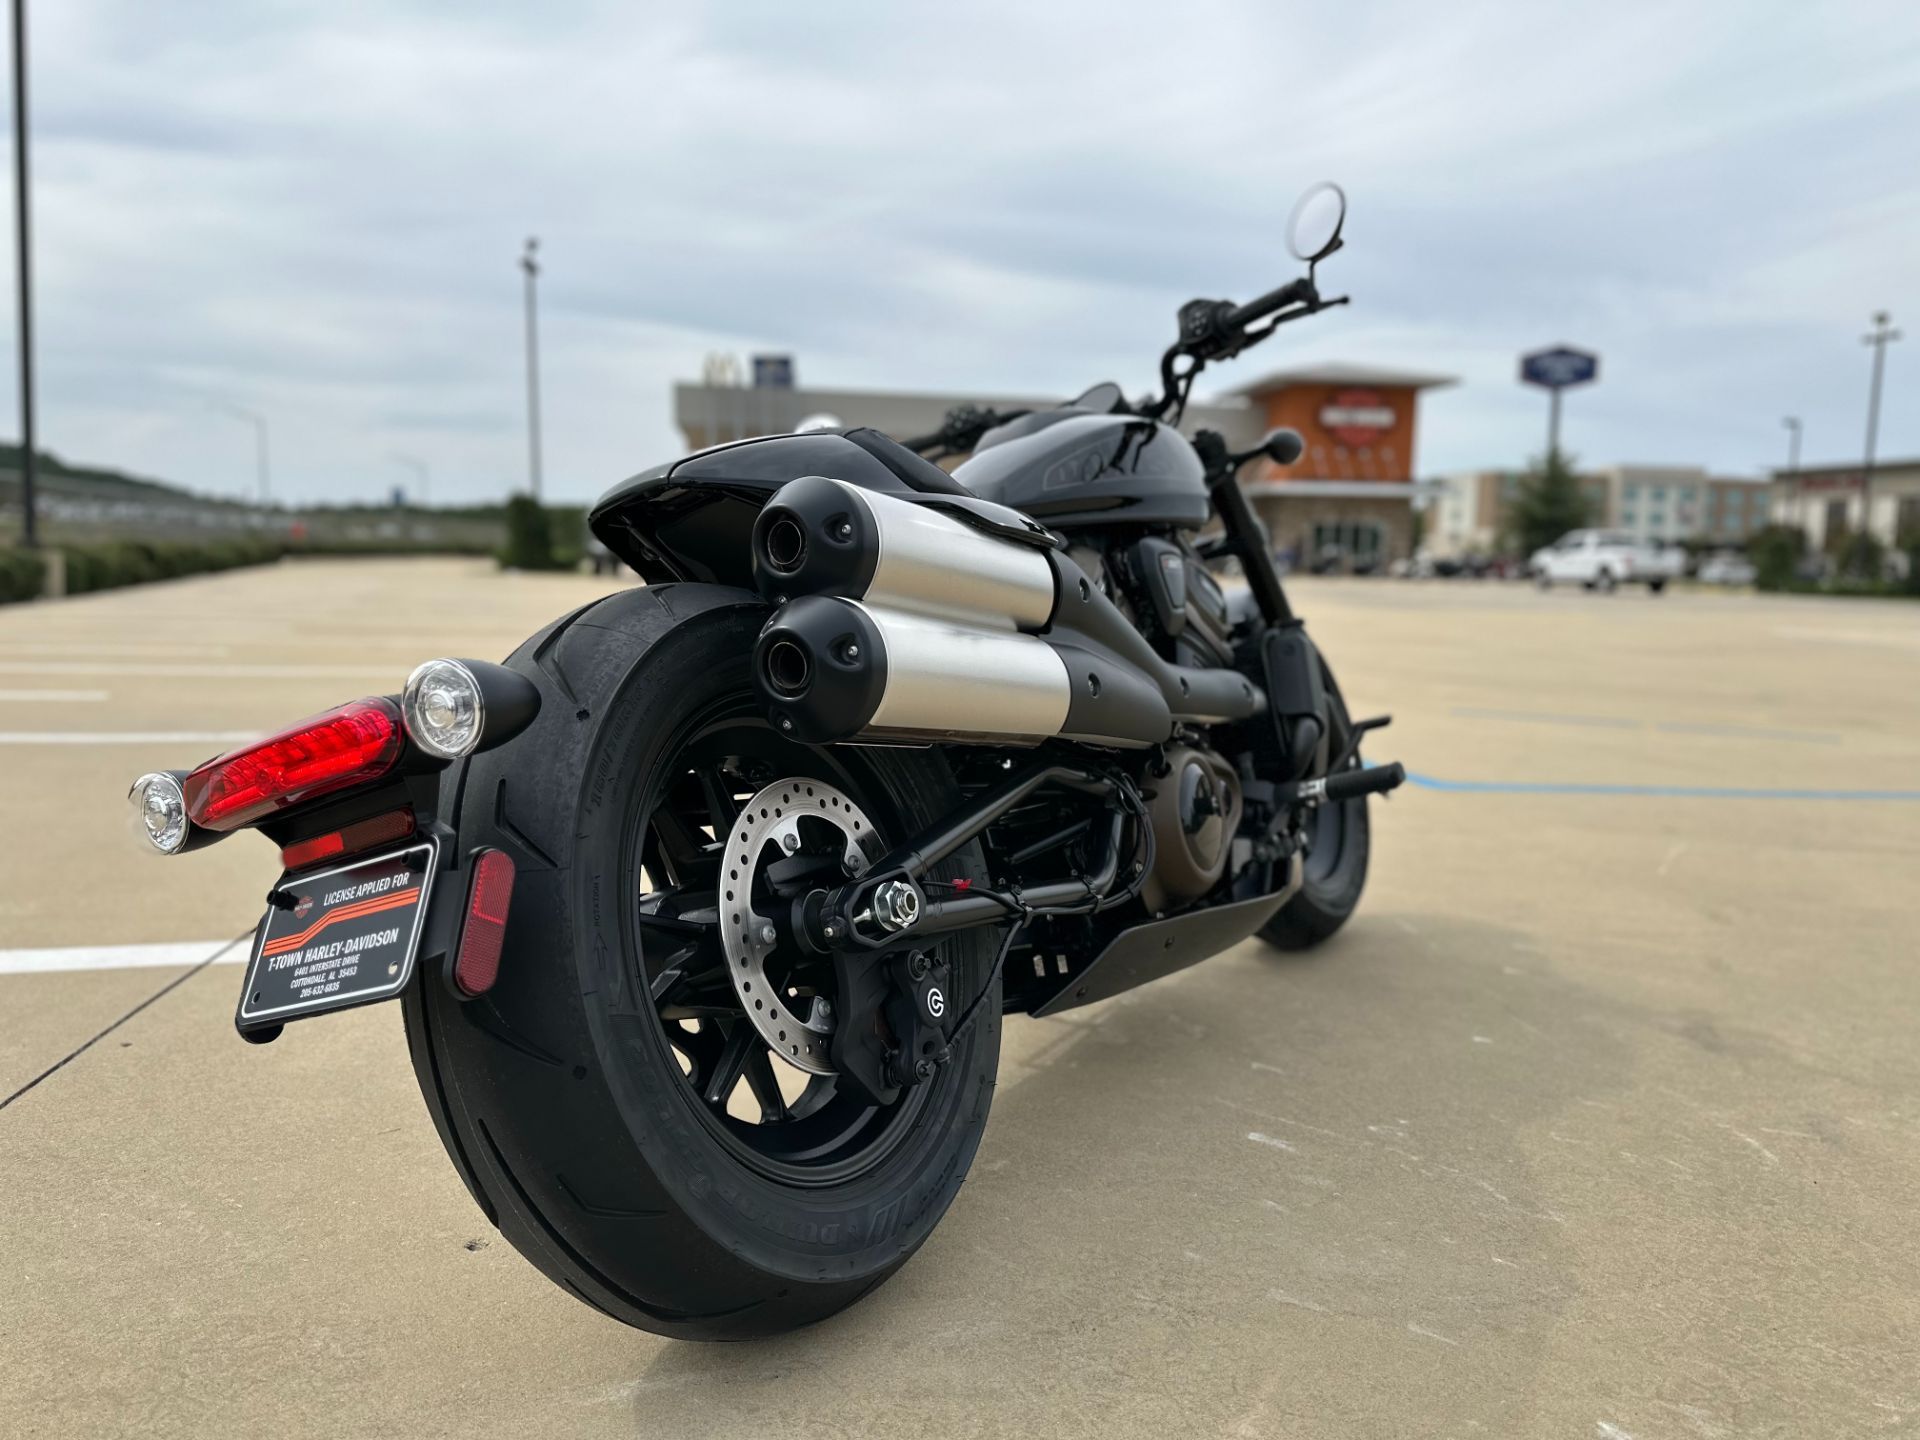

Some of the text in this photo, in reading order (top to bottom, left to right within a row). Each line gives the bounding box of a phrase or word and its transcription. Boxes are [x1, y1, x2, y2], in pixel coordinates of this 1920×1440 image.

[324, 872, 409, 906] LICENSE APPLIED FOR
[267, 927, 400, 972] T-TOWN HARLEY-DAVIDSON
[309, 957, 342, 973] INTERSTATE
[341, 954, 360, 966] DRIVE
[327, 970, 337, 981] AL
